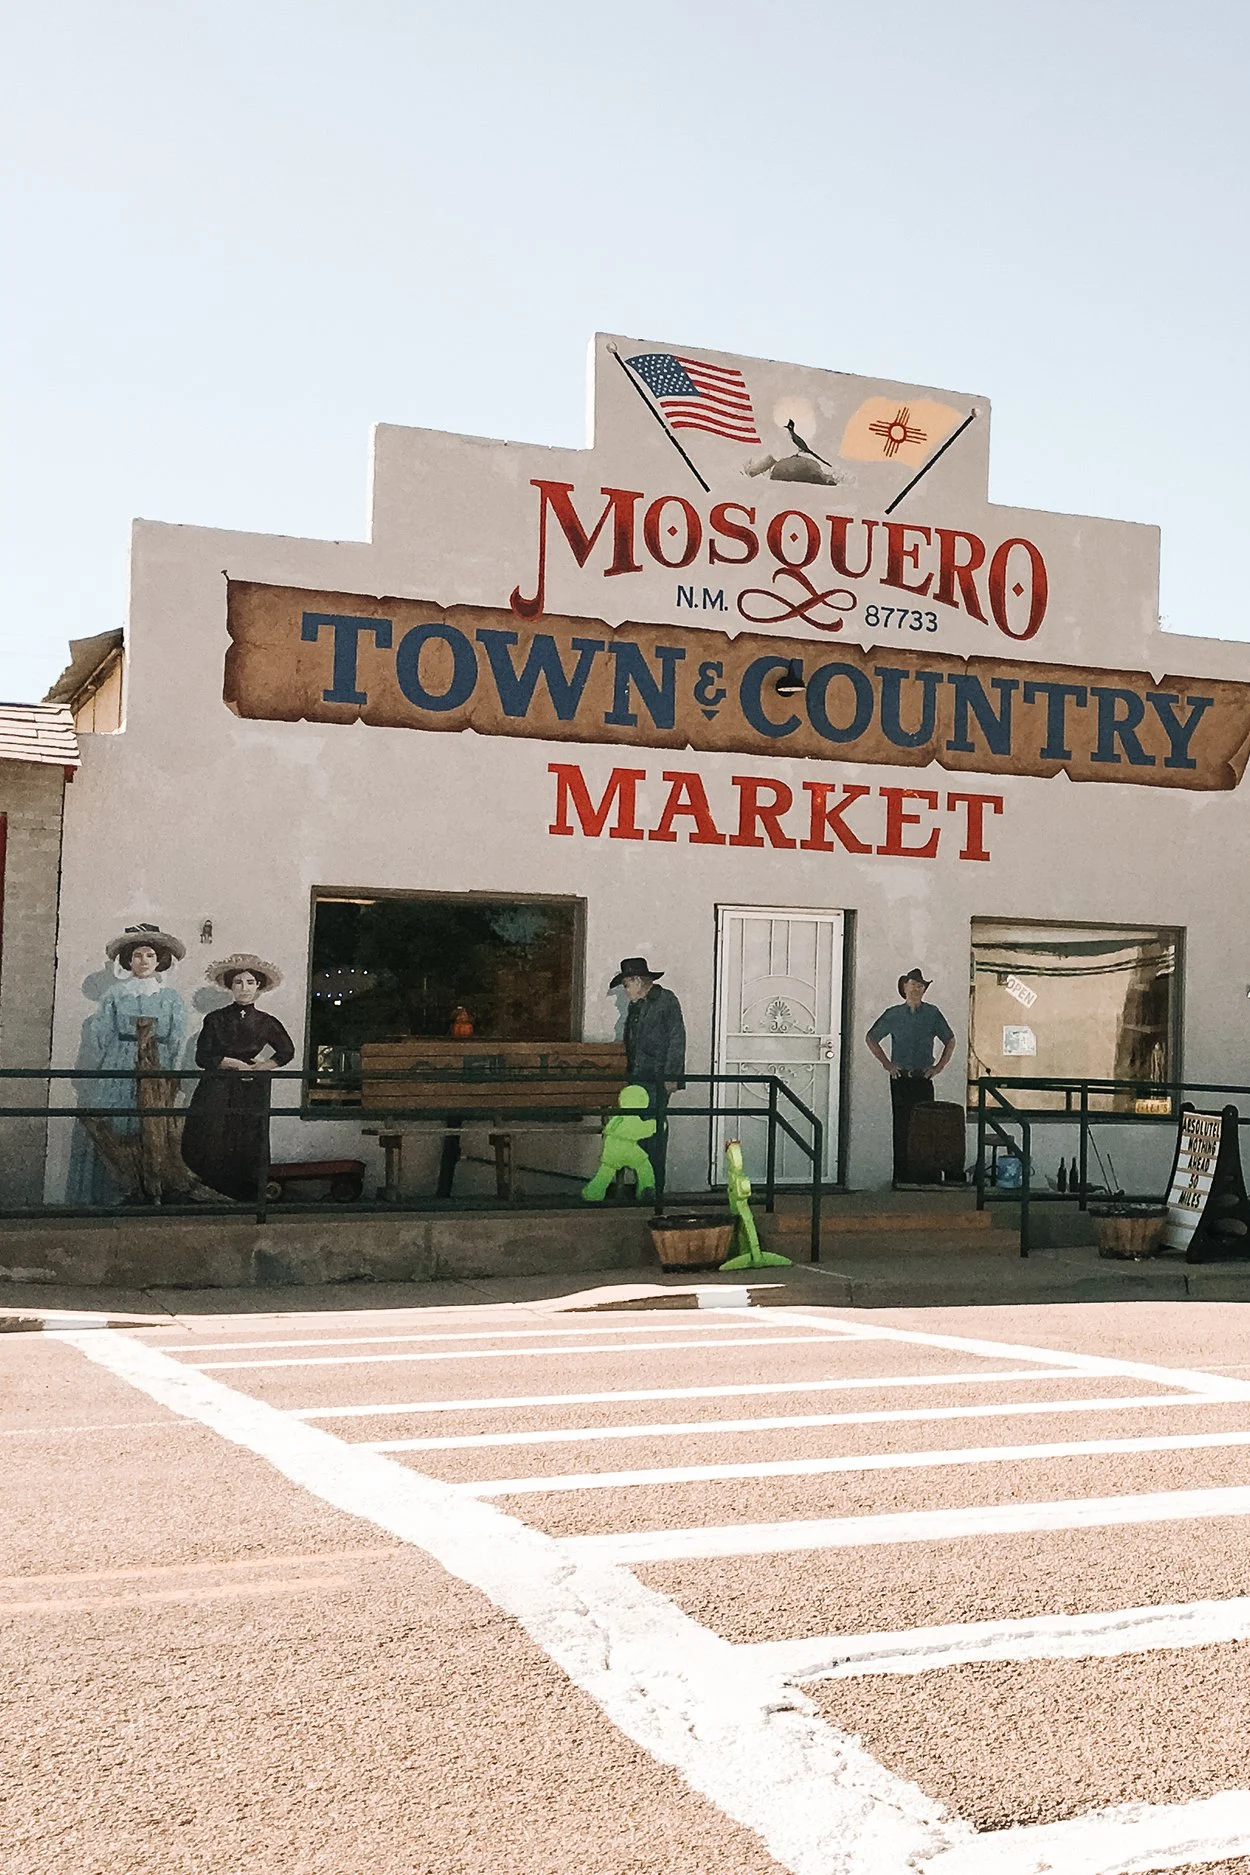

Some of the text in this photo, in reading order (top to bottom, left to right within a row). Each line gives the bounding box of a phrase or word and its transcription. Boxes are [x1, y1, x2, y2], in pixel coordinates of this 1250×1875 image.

[509, 478, 1048, 640] MOSQUERO
[675, 584, 939, 634] N.M. 87733
[300, 611, 1214, 771] TOWN & COUNTRY
[546, 762, 1004, 863] MARKET
[1007, 978, 1035, 1005] OPEN
[1187, 1136, 1216, 1156] NOTHING
[1187, 1155, 1210, 1172] AHEAD
[1189, 1173, 1199, 1189] 50
[1178, 1190, 1201, 1208] MILES
